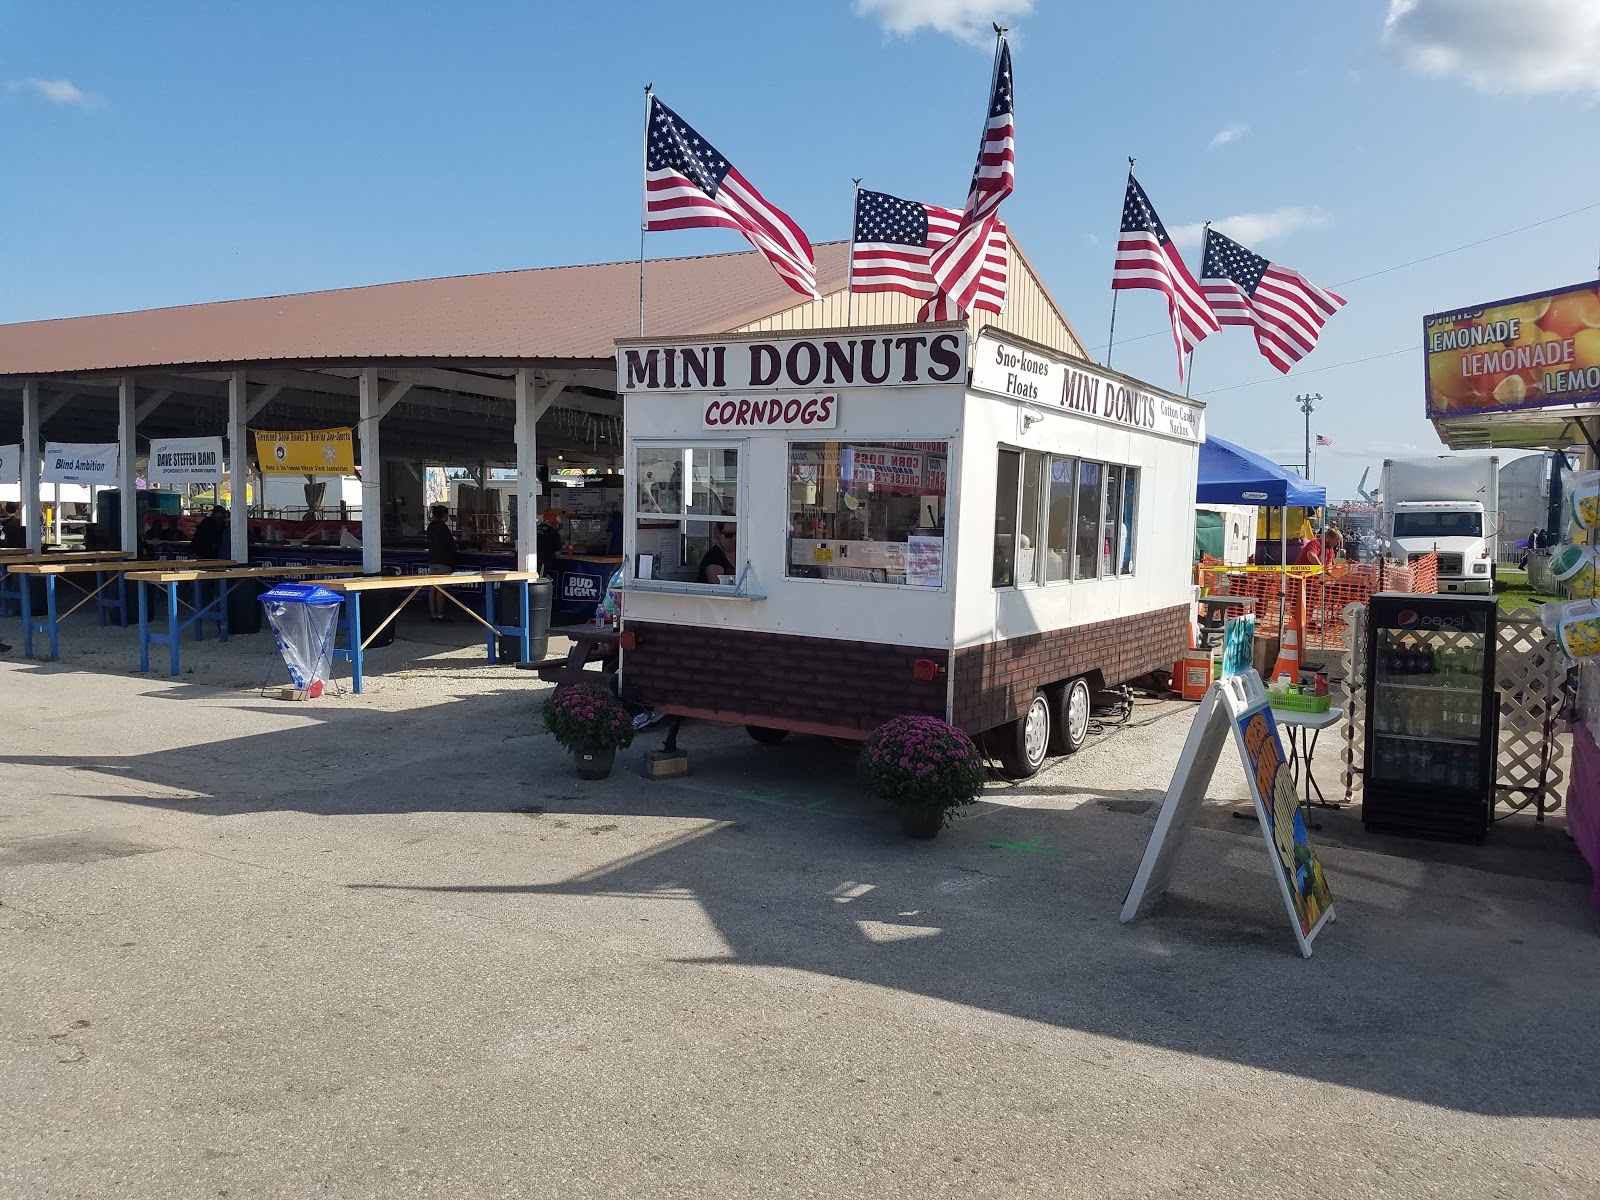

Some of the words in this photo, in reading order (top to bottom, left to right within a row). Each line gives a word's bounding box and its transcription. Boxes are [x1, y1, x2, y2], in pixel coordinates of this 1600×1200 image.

[625, 346, 727, 388] MINI
[749, 334, 961, 386] DONUTS
[1462, 339, 1575, 377] LEMONADE
[1006, 372, 1038, 400] Floats
[1545, 366, 1600, 394] LEMO
[705, 395, 834, 426] CORNDOGS
[1060, 368, 1100, 414] MINI
[1104, 382, 1155, 428] DONUTS
[1160, 400, 1179, 420] Cotton
[1180, 405, 1196, 425] Candy
[1169, 418, 1189, 437] Nachos
[55, 458, 74, 470] Blind
[75, 460, 105, 471] Ambition
[157, 453, 172, 466] DAVE
[173, 453, 196, 466] STEFFEN
[198, 452, 216, 465] BAND
[564, 585, 598, 598] LIGHT
[569, 576, 594, 589] BUD
[1422, 616, 1464, 628] pepsi
